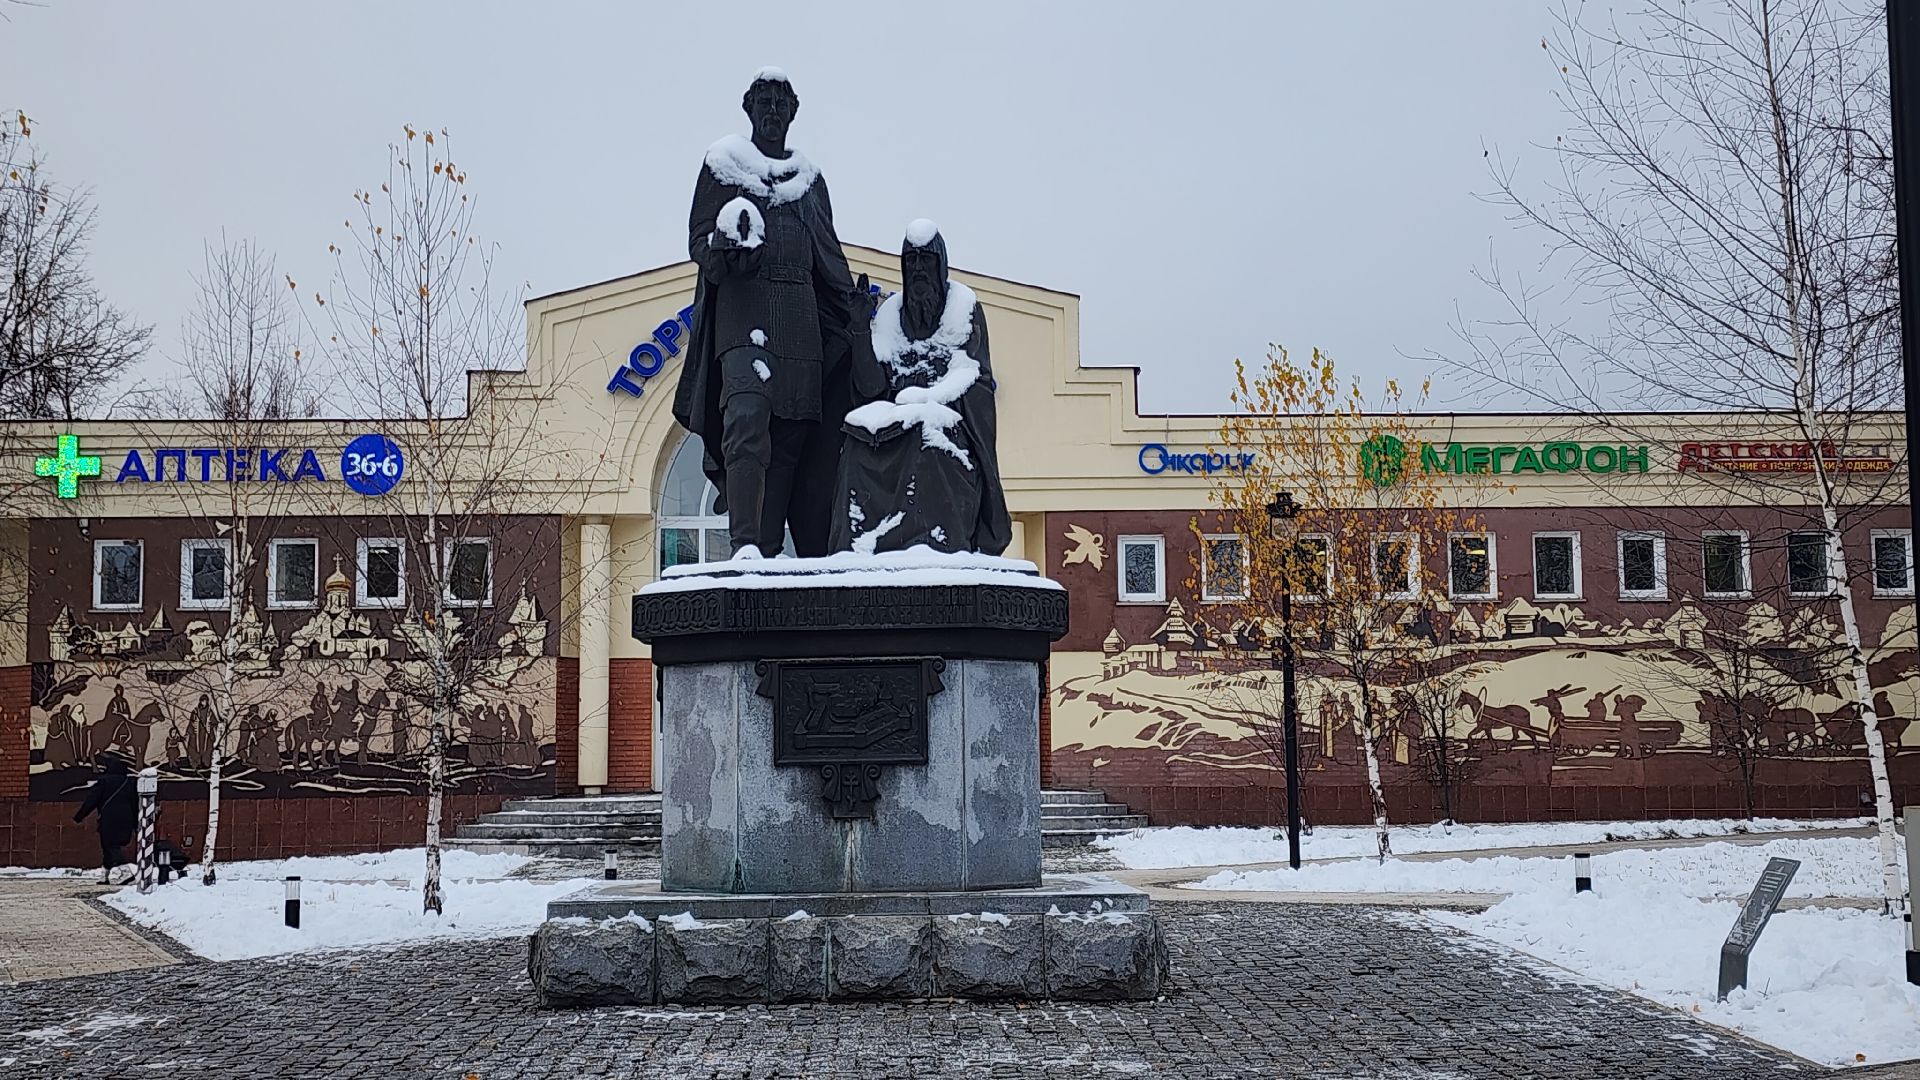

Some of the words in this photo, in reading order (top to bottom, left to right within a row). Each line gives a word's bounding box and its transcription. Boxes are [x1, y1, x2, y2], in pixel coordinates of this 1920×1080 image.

[116, 449, 326, 482] АПТЕКА
[1770, 461, 1836, 471] ПОДГУЗНКИ
[1847, 461, 1890, 471] ОДЕЖДА
